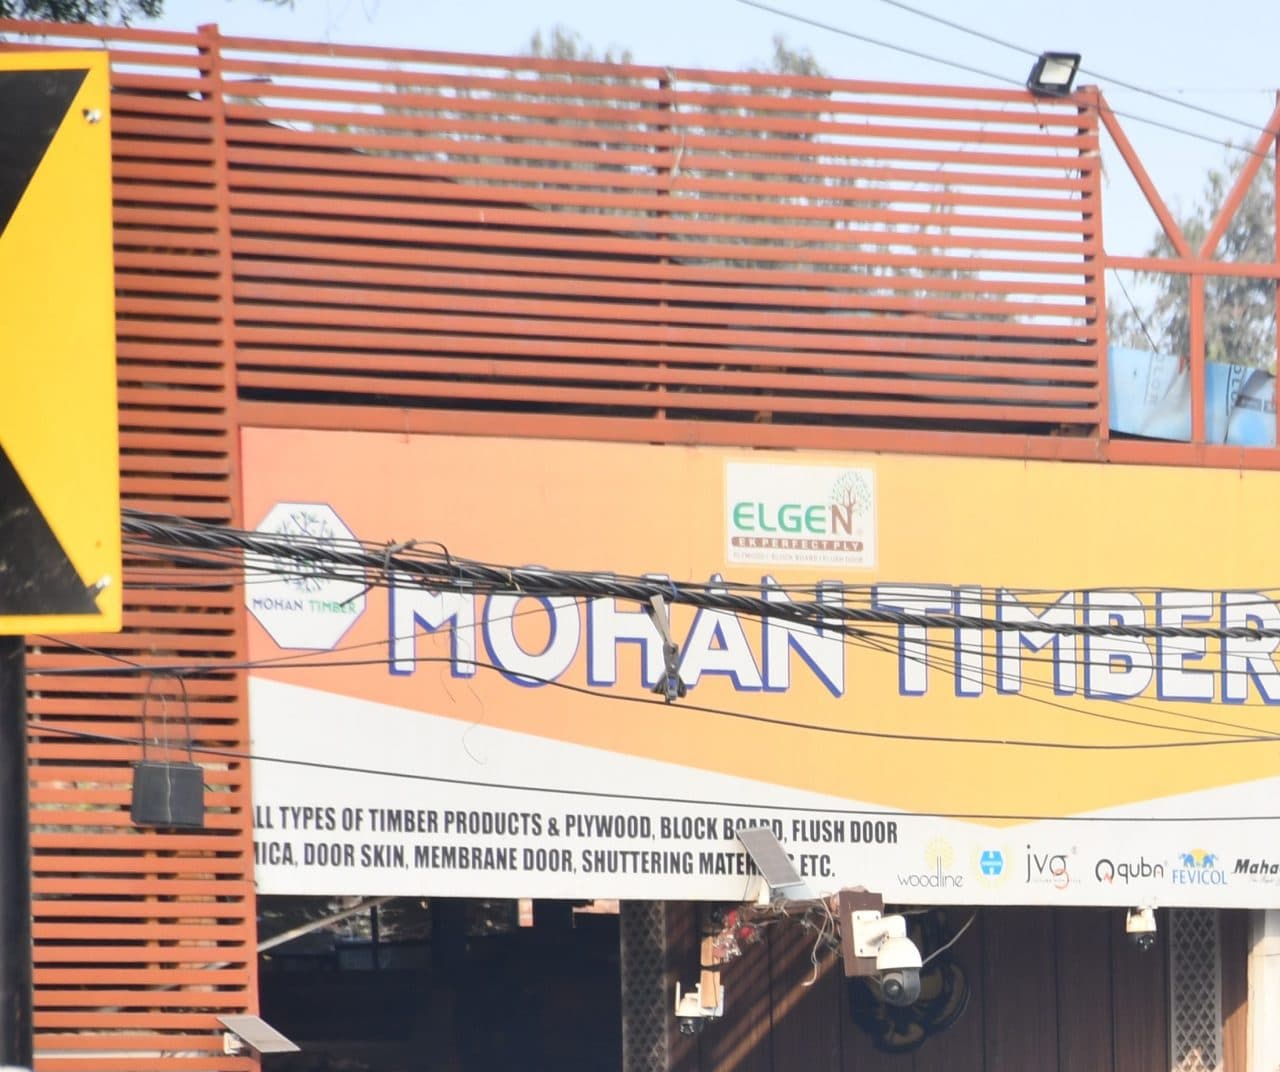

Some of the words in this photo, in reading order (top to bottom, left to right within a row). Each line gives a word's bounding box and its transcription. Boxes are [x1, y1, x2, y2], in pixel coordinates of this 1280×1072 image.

[733, 501, 853, 535] ELGEN
[761, 539, 828, 550] PERFECT
[833, 542, 860, 551] PLY
[252, 598, 304, 611] MOHAN
[309, 600, 358, 613] TIMBER
[389, 565, 845, 698] MOHAN
[253, 806, 274, 829] LL
[279, 806, 336, 831] TYPES
[342, 808, 364, 832] OF
[369, 808, 439, 833] TIMBER
[444, 810, 543, 836] PRODUCTS
[547, 816, 561, 836] &
[566, 813, 656, 841] PLYWOOD,
[661, 816, 718, 841] BLOCK
[792, 819, 845, 843] FLUSH
[850, 820, 898, 844] DOOR
[303, 842, 355, 867] DOOR
[361, 844, 409, 870] SKIN,
[414, 845, 518, 871] MEMBRANE
[523, 848, 577, 874] DOOR,
[582, 850, 694, 875] SHUTTERING
[800, 854, 836, 878] ETC.
[896, 856, 964, 888] woodline
[1172, 869, 1229, 885] FEVICOL
